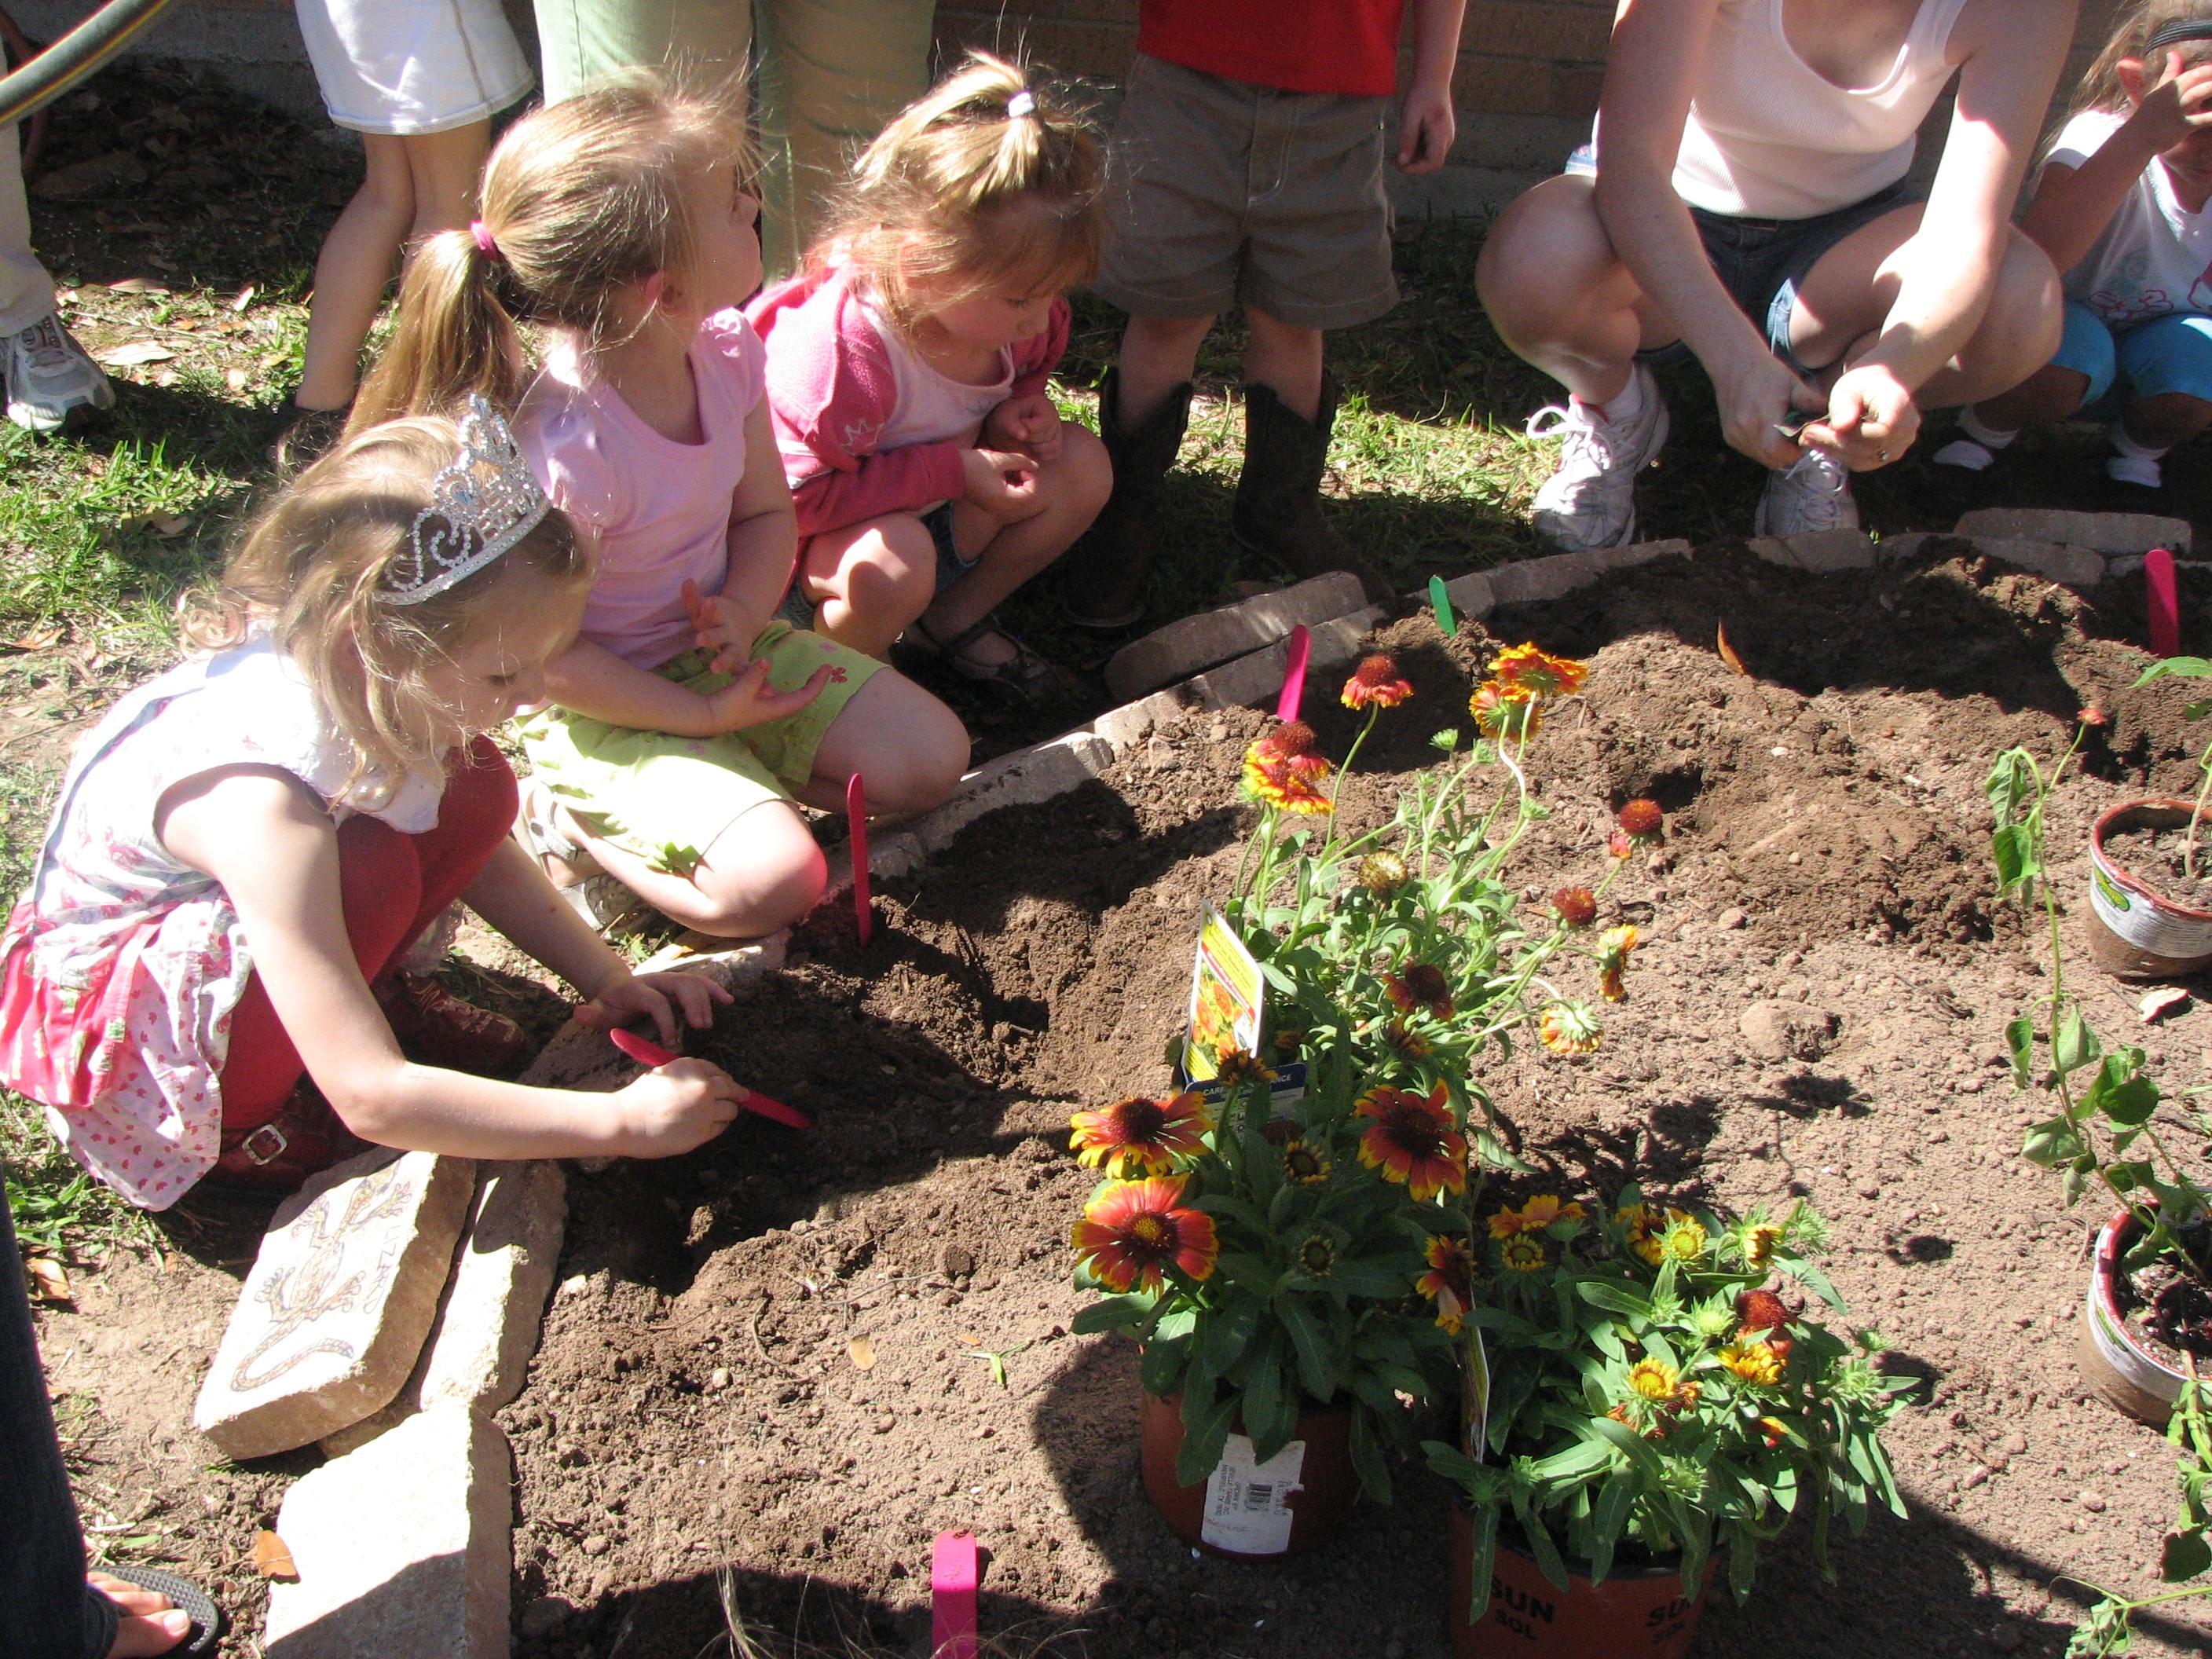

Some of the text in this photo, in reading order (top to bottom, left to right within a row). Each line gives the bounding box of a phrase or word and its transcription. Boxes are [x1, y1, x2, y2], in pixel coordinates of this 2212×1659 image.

[361, 1225, 401, 1315] LIZARD
[1489, 1574, 1555, 1624] SUN
[1495, 1608, 1536, 1641] SOL
